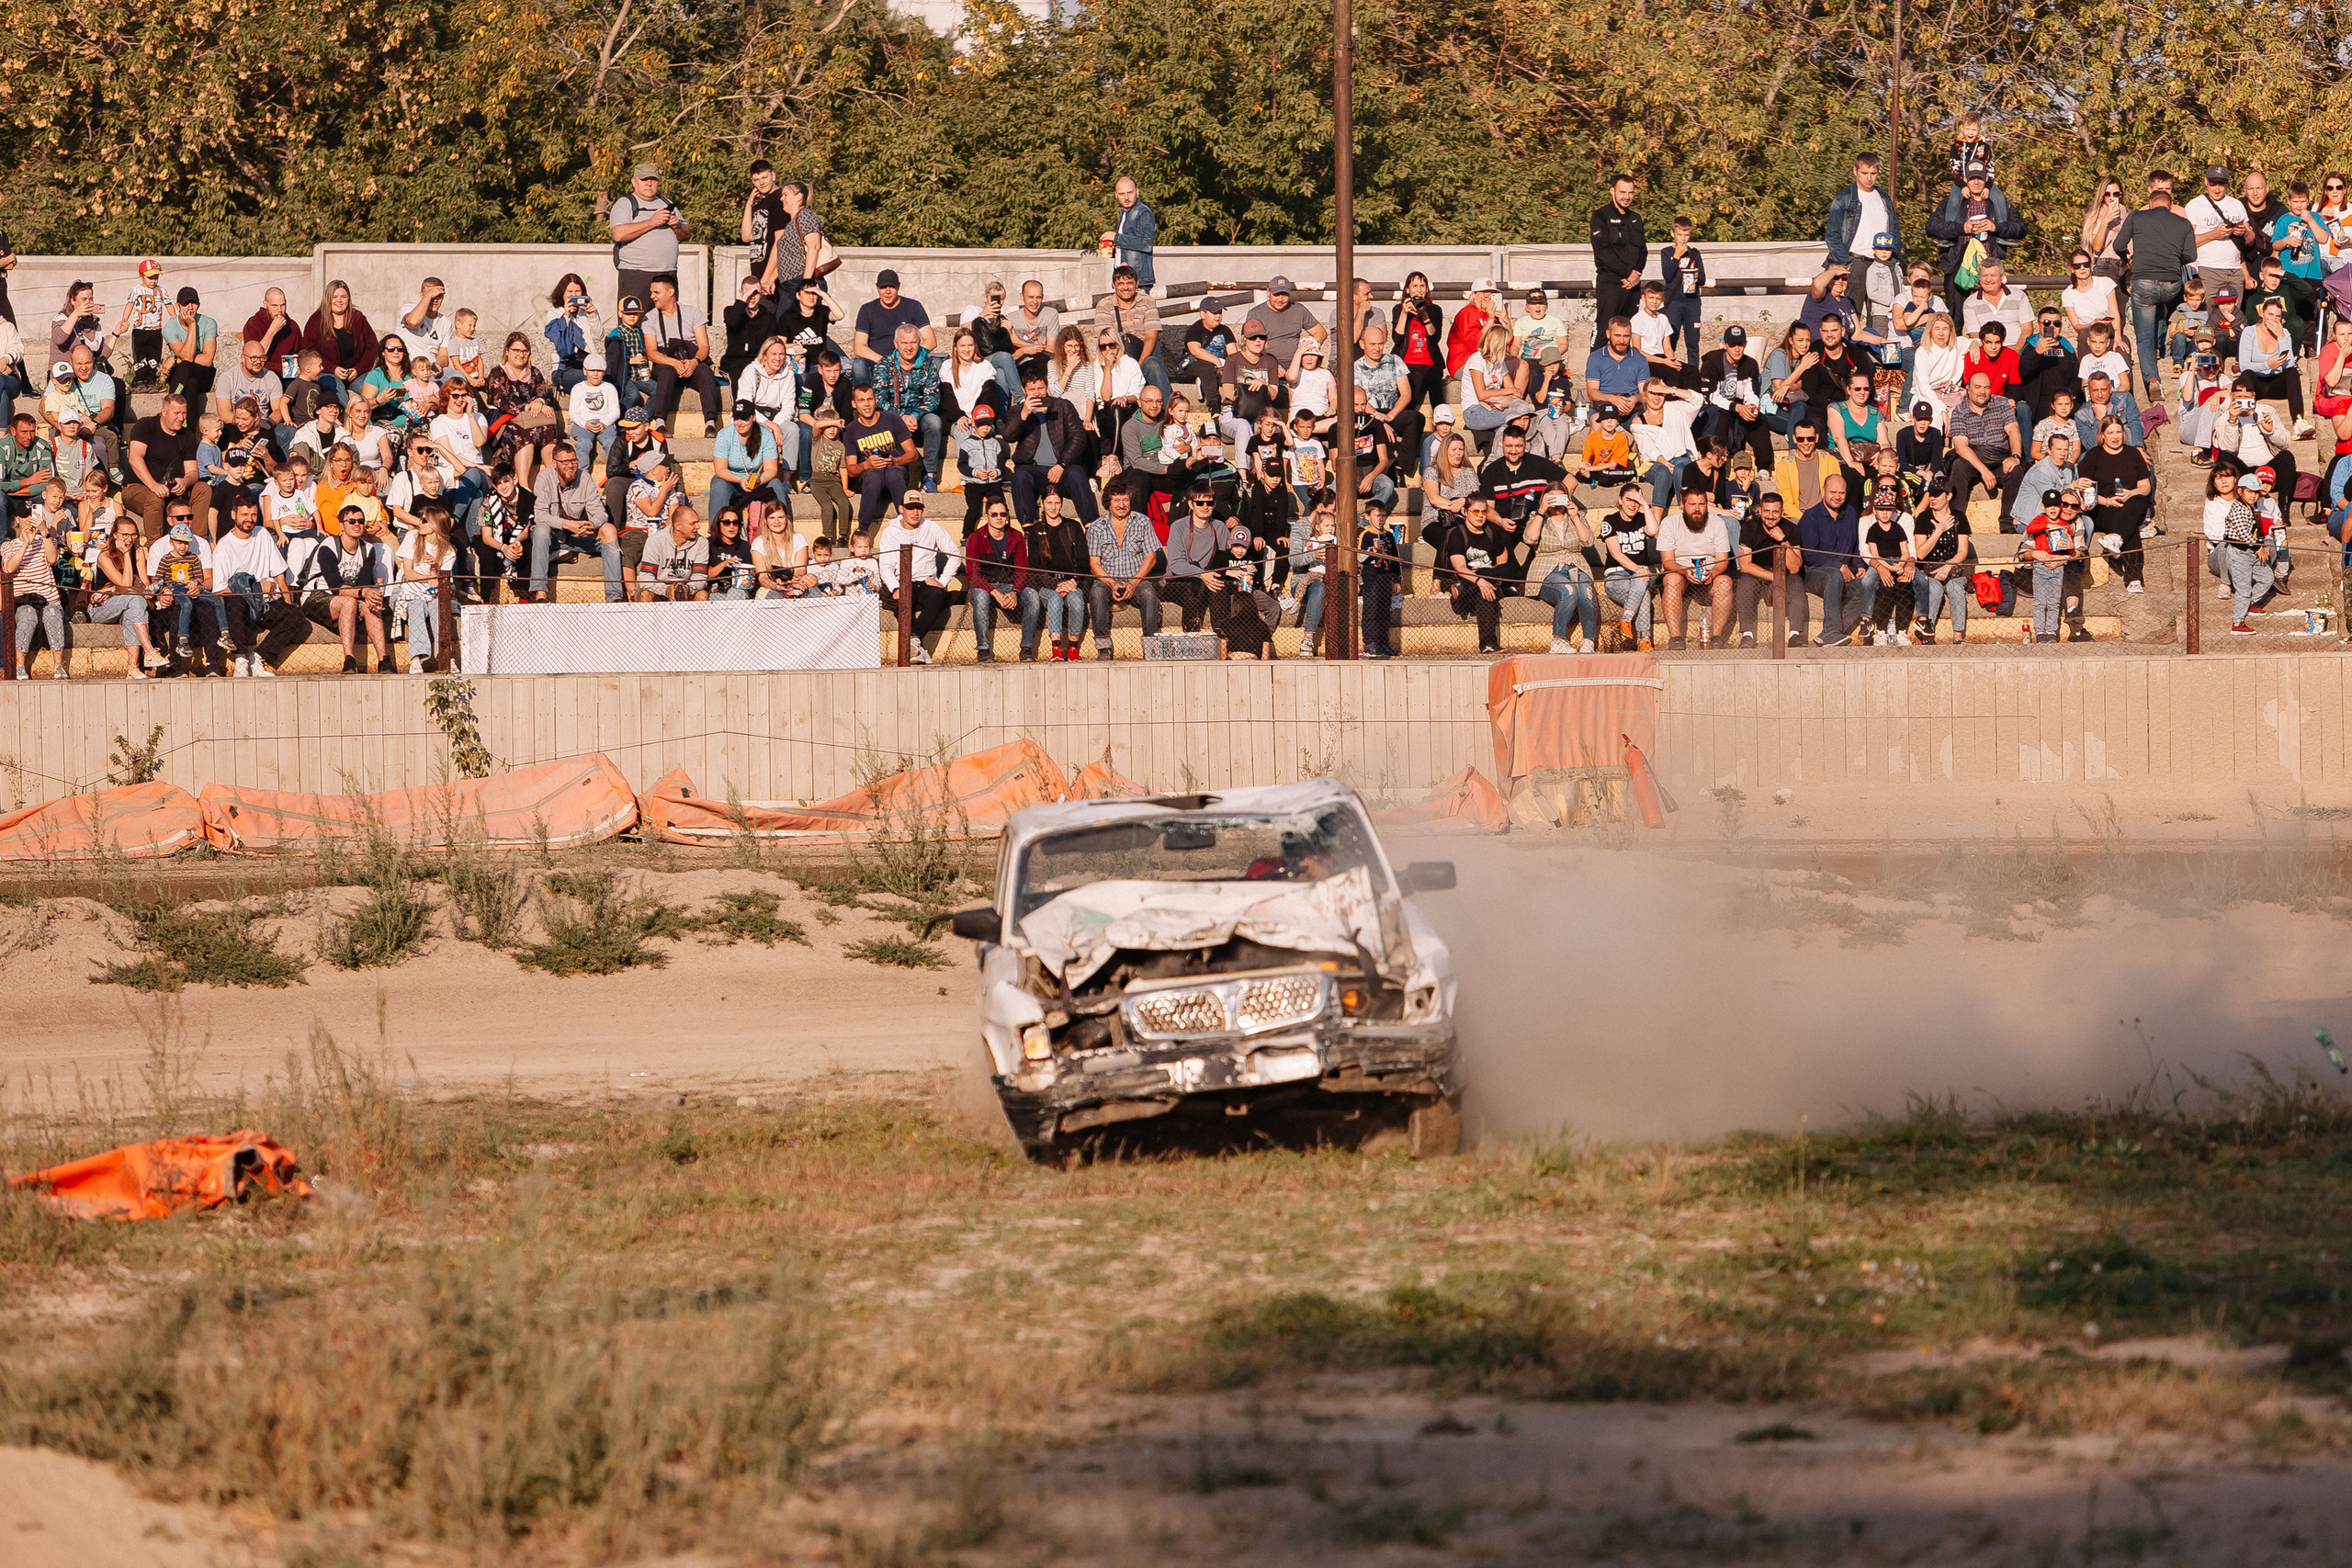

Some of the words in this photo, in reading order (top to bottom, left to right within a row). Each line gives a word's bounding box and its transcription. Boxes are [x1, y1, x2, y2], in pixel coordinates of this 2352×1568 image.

[2204, 213, 2242, 227] Whikey
[794, 336, 823, 345] adidas
[856, 430, 894, 452] PUMA
[1622, 540, 1645, 553] CLUB
[662, 558, 694, 570] JAPAN
